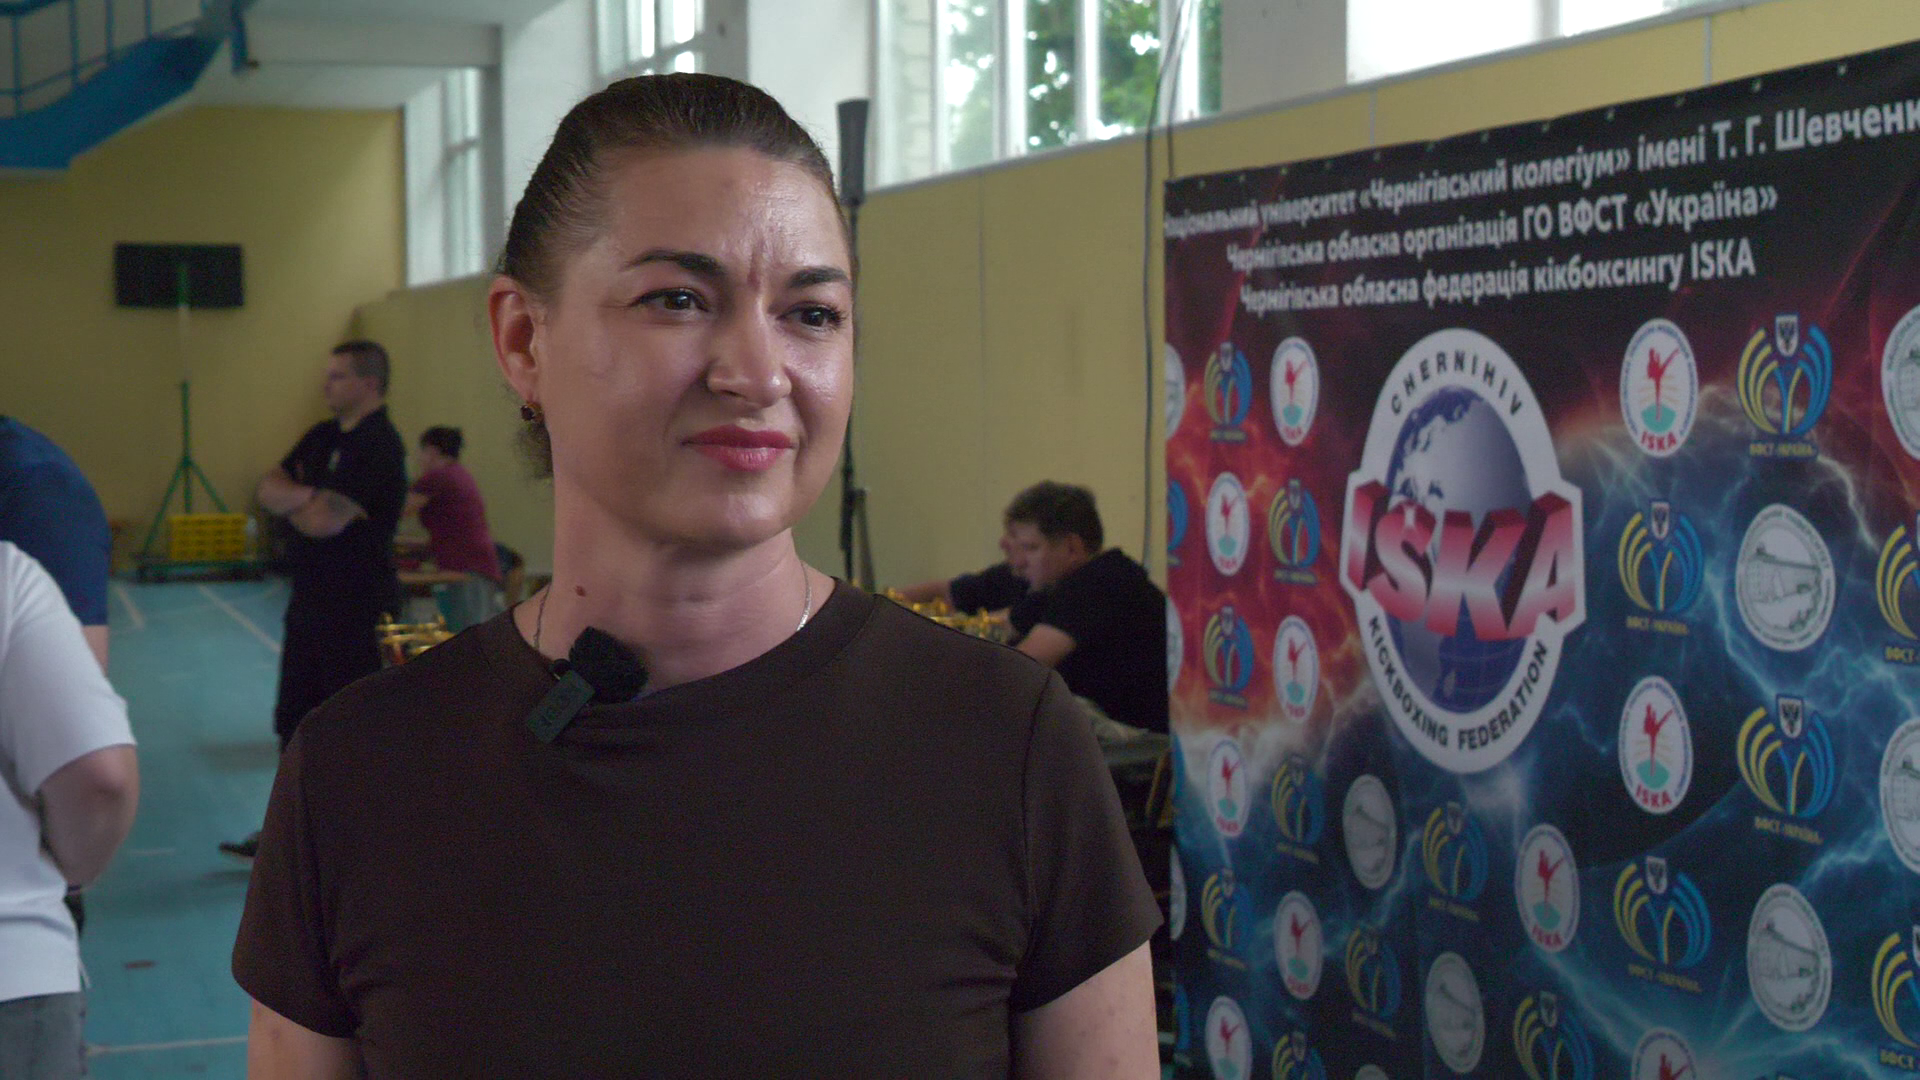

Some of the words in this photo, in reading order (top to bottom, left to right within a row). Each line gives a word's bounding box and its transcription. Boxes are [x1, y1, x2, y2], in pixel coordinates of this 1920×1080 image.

[1164, 200, 1259, 240] аціональний
[1260, 190, 1357, 233] університет
[1638, 125, 1705, 172] імені
[1712, 119, 1736, 160] Т.
[1745, 114, 1766, 156] Г.
[1227, 237, 1324, 277] Чернігівська
[1327, 230, 1400, 262] обласна
[1403, 209, 1518, 260] організація
[1522, 204, 1552, 241] ГО
[1558, 193, 1628, 237] ВФСТ
[1634, 180, 1778, 233] «Україна»
[1240, 280, 1339, 318] Чернігівська
[1342, 272, 1419, 306] обласна
[1422, 260, 1529, 309] федерація
[1534, 252, 1684, 292] кікбоксингу
[1691, 236, 1756, 281] ISKA
[1390, 349, 1523, 417] CHERNIHIV
[1640, 430, 1677, 452] ISKA
[1346, 478, 1577, 642] ISKA
[1369, 615, 1449, 748] KICKBOXING
[1457, 640, 1548, 751] FEDERATION
[1635, 784, 1673, 808] ISKA
